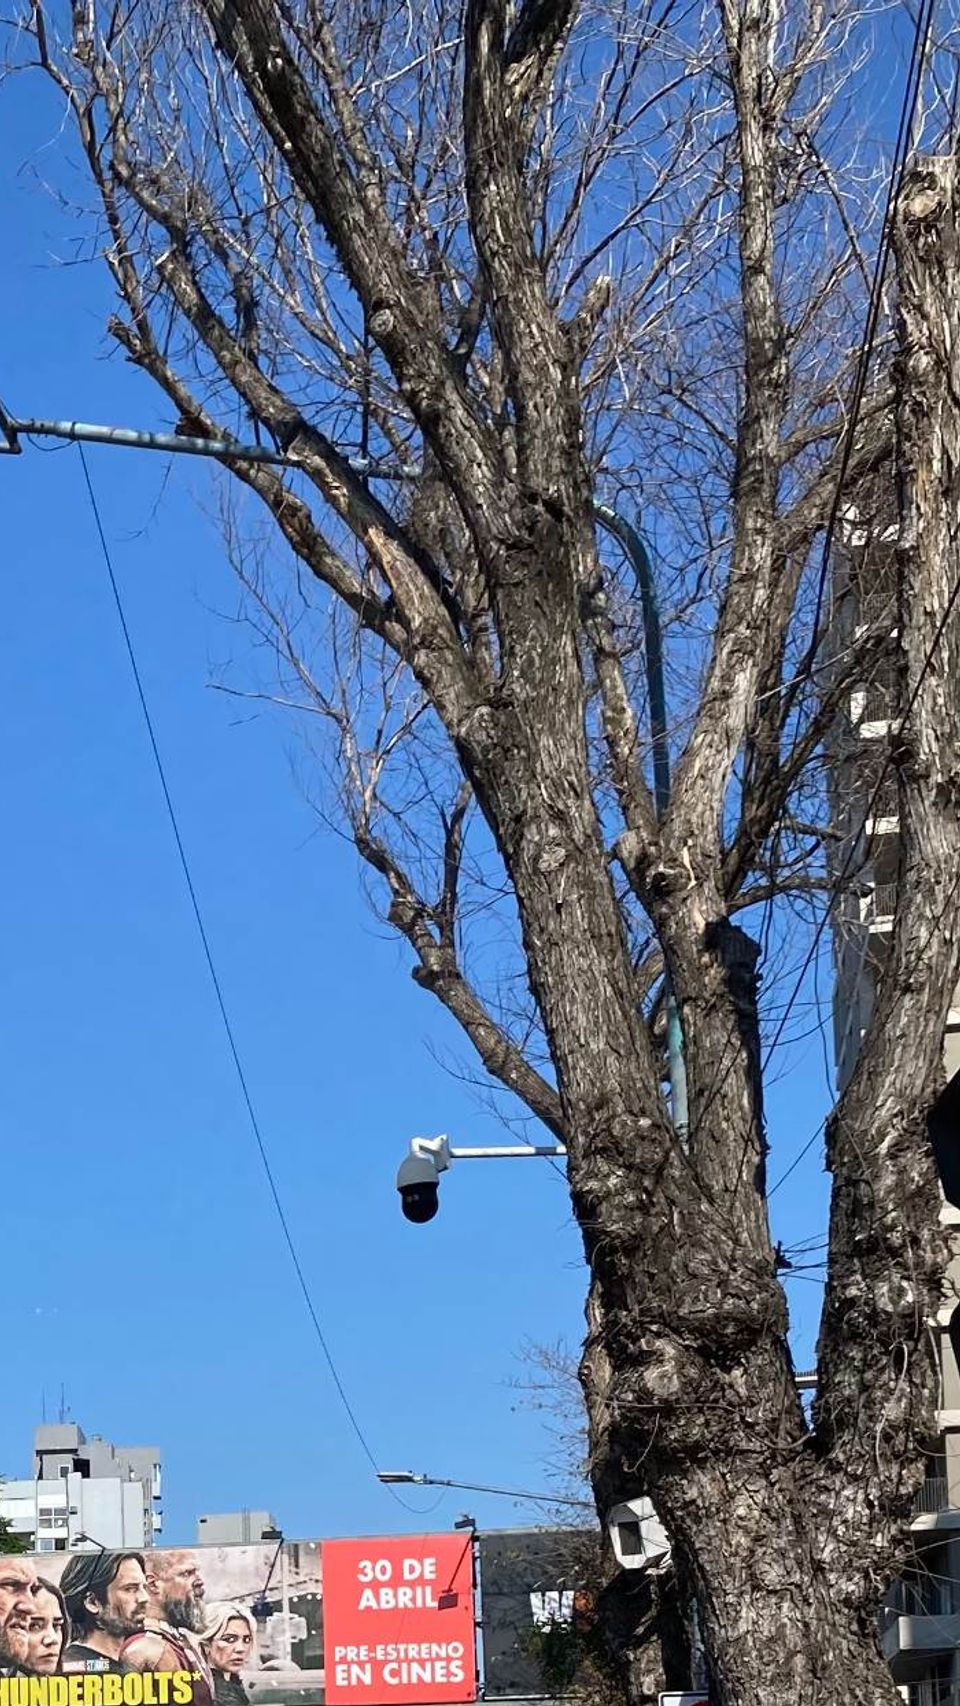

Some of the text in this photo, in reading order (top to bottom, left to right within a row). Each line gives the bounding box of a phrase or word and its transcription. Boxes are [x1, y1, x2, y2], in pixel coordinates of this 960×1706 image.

[357, 1558, 436, 1583] 30 DE
[358, 1586, 439, 1610] ABRIL
[334, 1642, 465, 1662] PRE-ESTRENO
[335, 1660, 465, 1686] EN CINES
